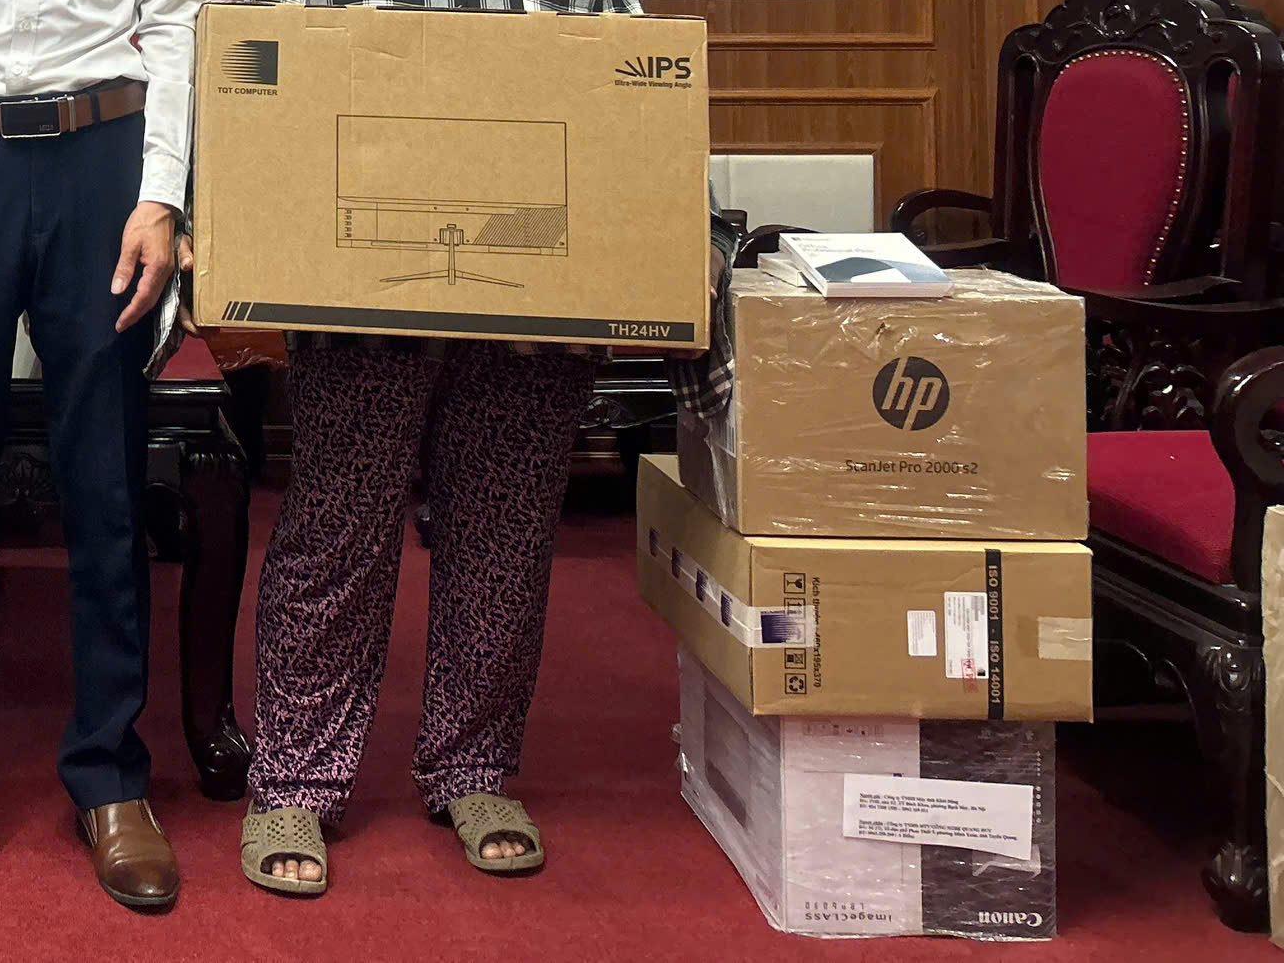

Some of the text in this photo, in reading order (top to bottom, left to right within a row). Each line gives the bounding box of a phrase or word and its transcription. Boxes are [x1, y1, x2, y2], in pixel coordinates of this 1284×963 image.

[648, 57, 691, 79] IPS
[608, 324, 670, 337] TH24HV
[882, 357, 942, 430] hp
[845, 460, 978, 474] ScanJet Pro 2000 s2
[988, 565, 998, 587] ISO
[989, 591, 998, 620] 9001
[990, 640, 999, 662] ISO
[991, 667, 1000, 703] 14001
[805, 912, 892, 922] imageCLASS
[978, 912, 1043, 927] Canon
